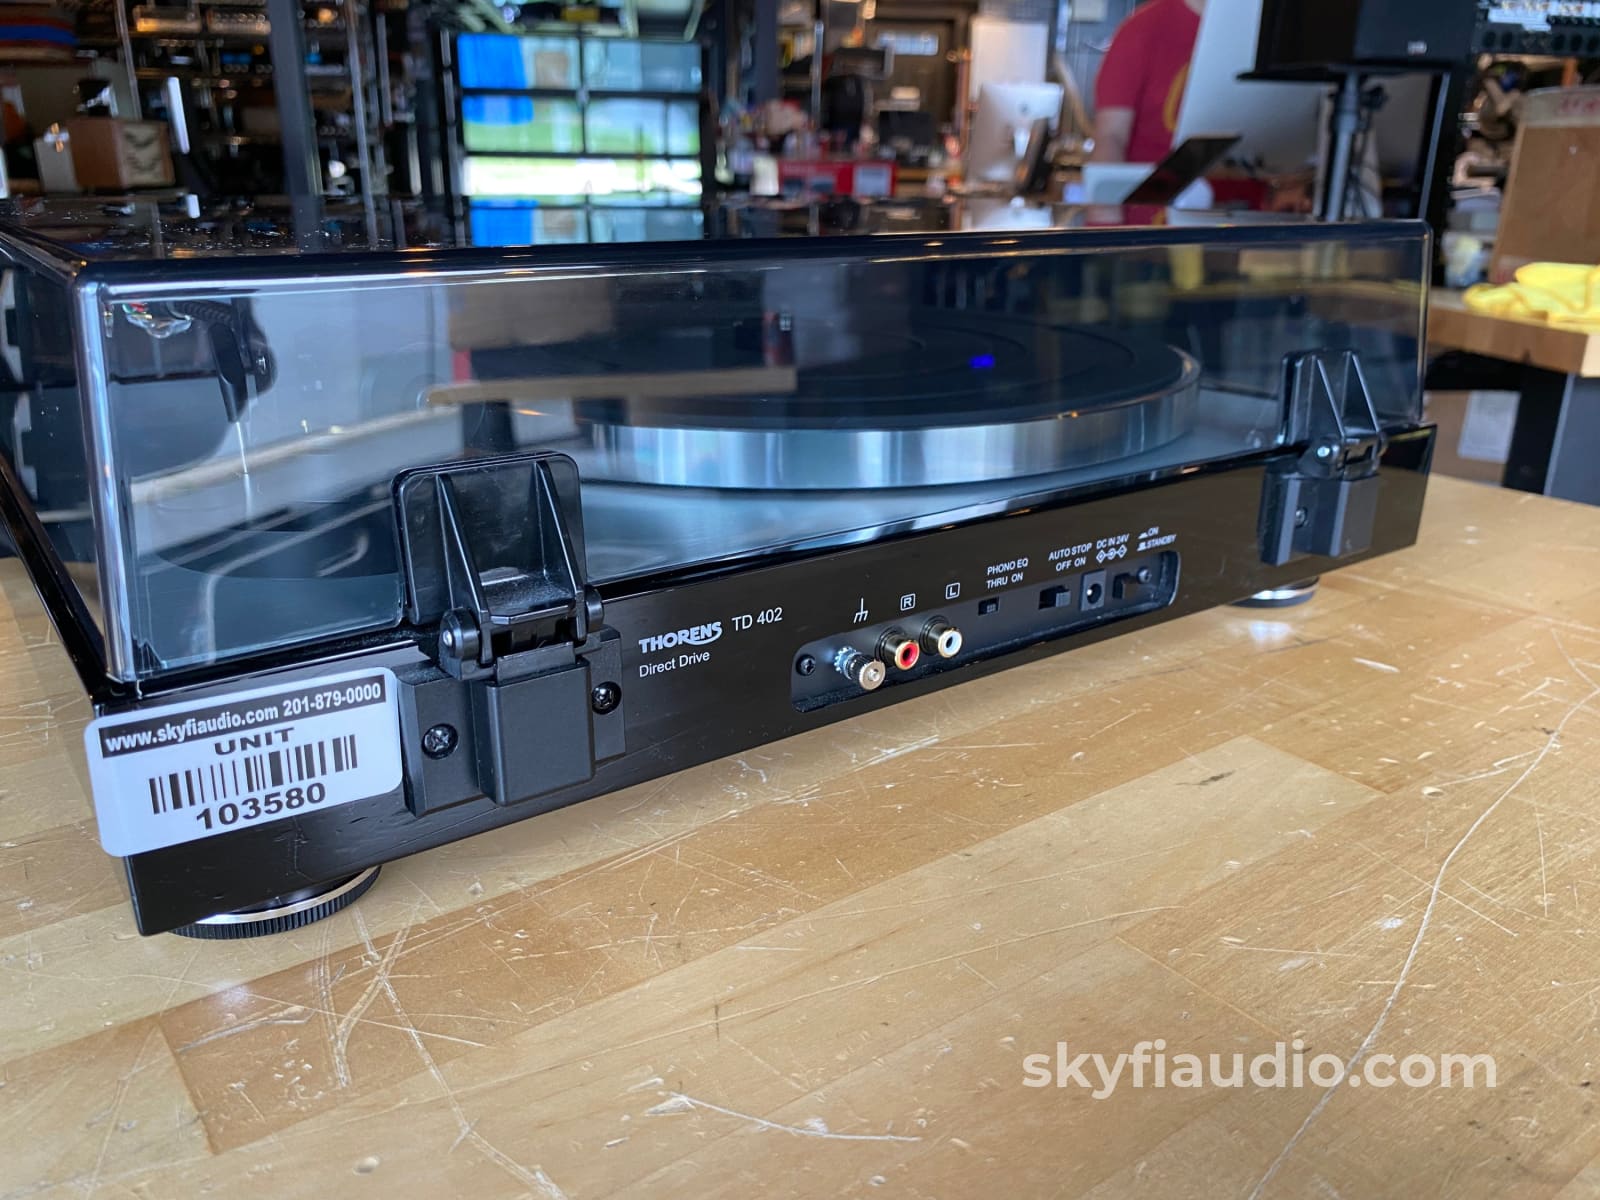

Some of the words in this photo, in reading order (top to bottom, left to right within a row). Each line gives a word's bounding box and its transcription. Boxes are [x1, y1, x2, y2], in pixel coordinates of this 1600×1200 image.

[1146, 533, 1177, 549] STANDBY
[1147, 526, 1159, 537] ON
[1096, 539, 1107, 550] DC
[1107, 537, 1115, 547] IN
[1115, 533, 1130, 545] 24V
[1048, 548, 1071, 561] AUTO
[1071, 542, 1093, 556] STOP
[987, 562, 1016, 576] PHONO
[1016, 557, 1029, 569] EQ
[1055, 561, 1071, 572] OFF
[1074, 556, 1087, 567] ON
[986, 576, 1009, 590] THRU
[1011, 572, 1024, 584] ON
[638, 621, 723, 654] THORENS
[731, 614, 753, 632] TD
[756, 606, 783, 626] 402
[639, 658, 676, 678] Direct
[679, 651, 711, 668] Drive
[105, 707, 279, 753] www.skyfiaudio.com
[283, 682, 382, 717] 201-879-0000
[214, 727, 295, 756] UNIT
[195, 782, 327, 830] 103580
